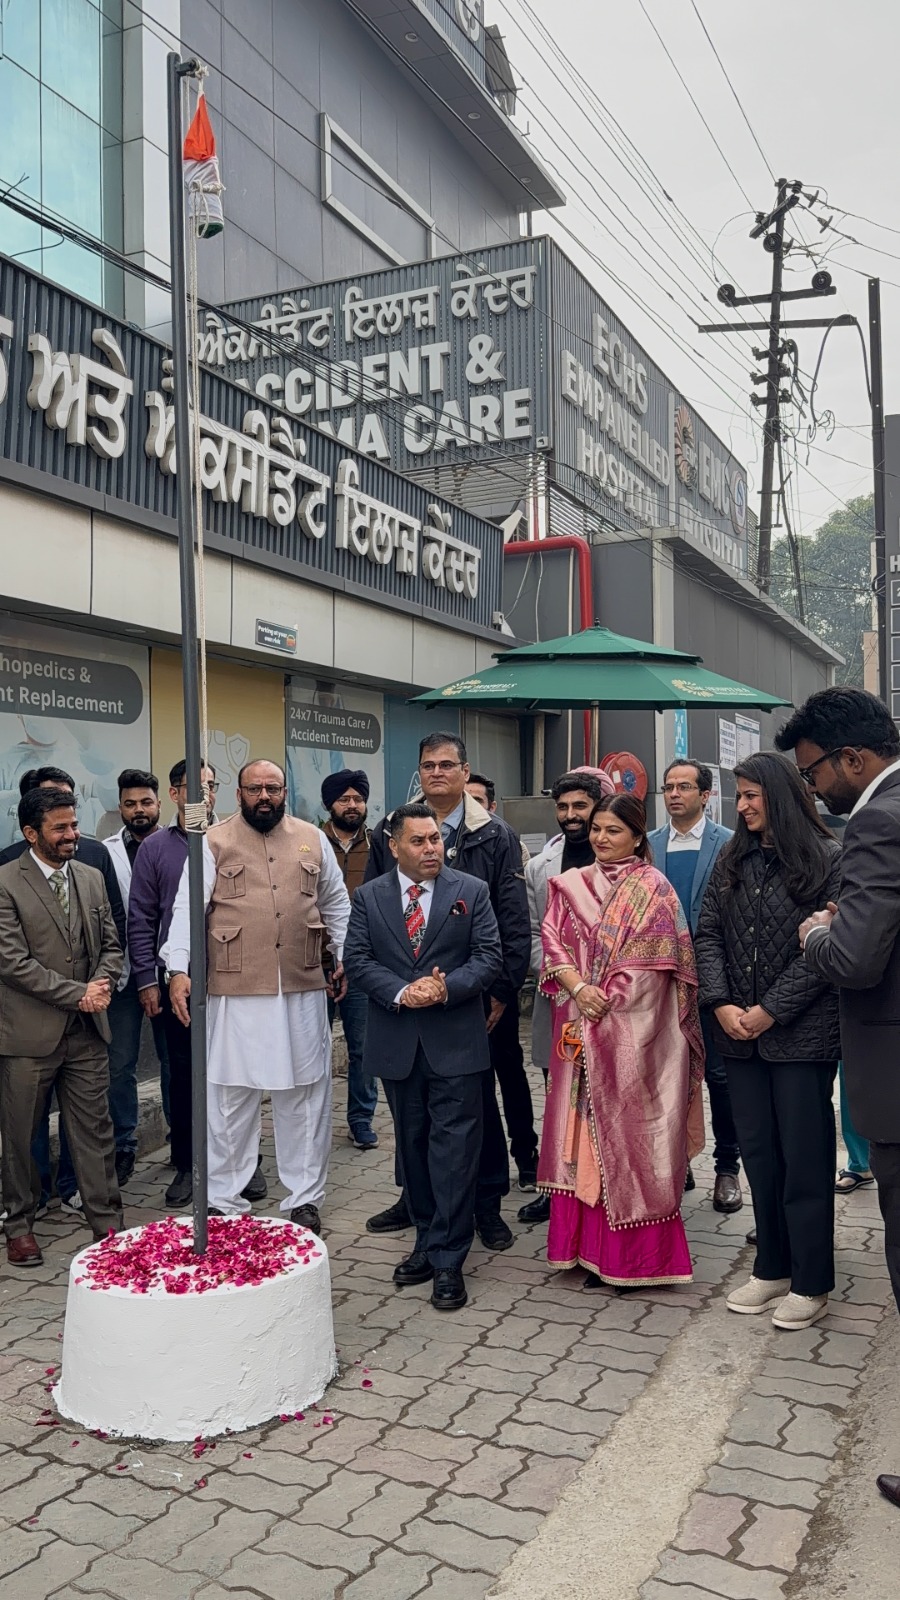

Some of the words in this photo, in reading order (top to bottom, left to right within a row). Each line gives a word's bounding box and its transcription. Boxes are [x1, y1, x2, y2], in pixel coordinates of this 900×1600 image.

[27, 328, 133, 459] ਅਤੇ
[234, 341, 450, 416] CCIDENT
[465, 334, 506, 385] &
[592, 312, 648, 415] ECHS
[404, 387, 532, 455] CARE
[561, 349, 670, 487] EMPANELLED
[577, 427, 661, 528] HOSPITAL
[698, 440, 731, 517] EMC
[19, 686, 124, 715] Replacement
[79, 666, 91, 684] &
[290, 707, 312, 721] 24x7
[313, 710, 346, 727] Trauma
[347, 715, 366, 730] Care
[290, 727, 330, 744] Accident
[331, 732, 374, 749] Treatment
